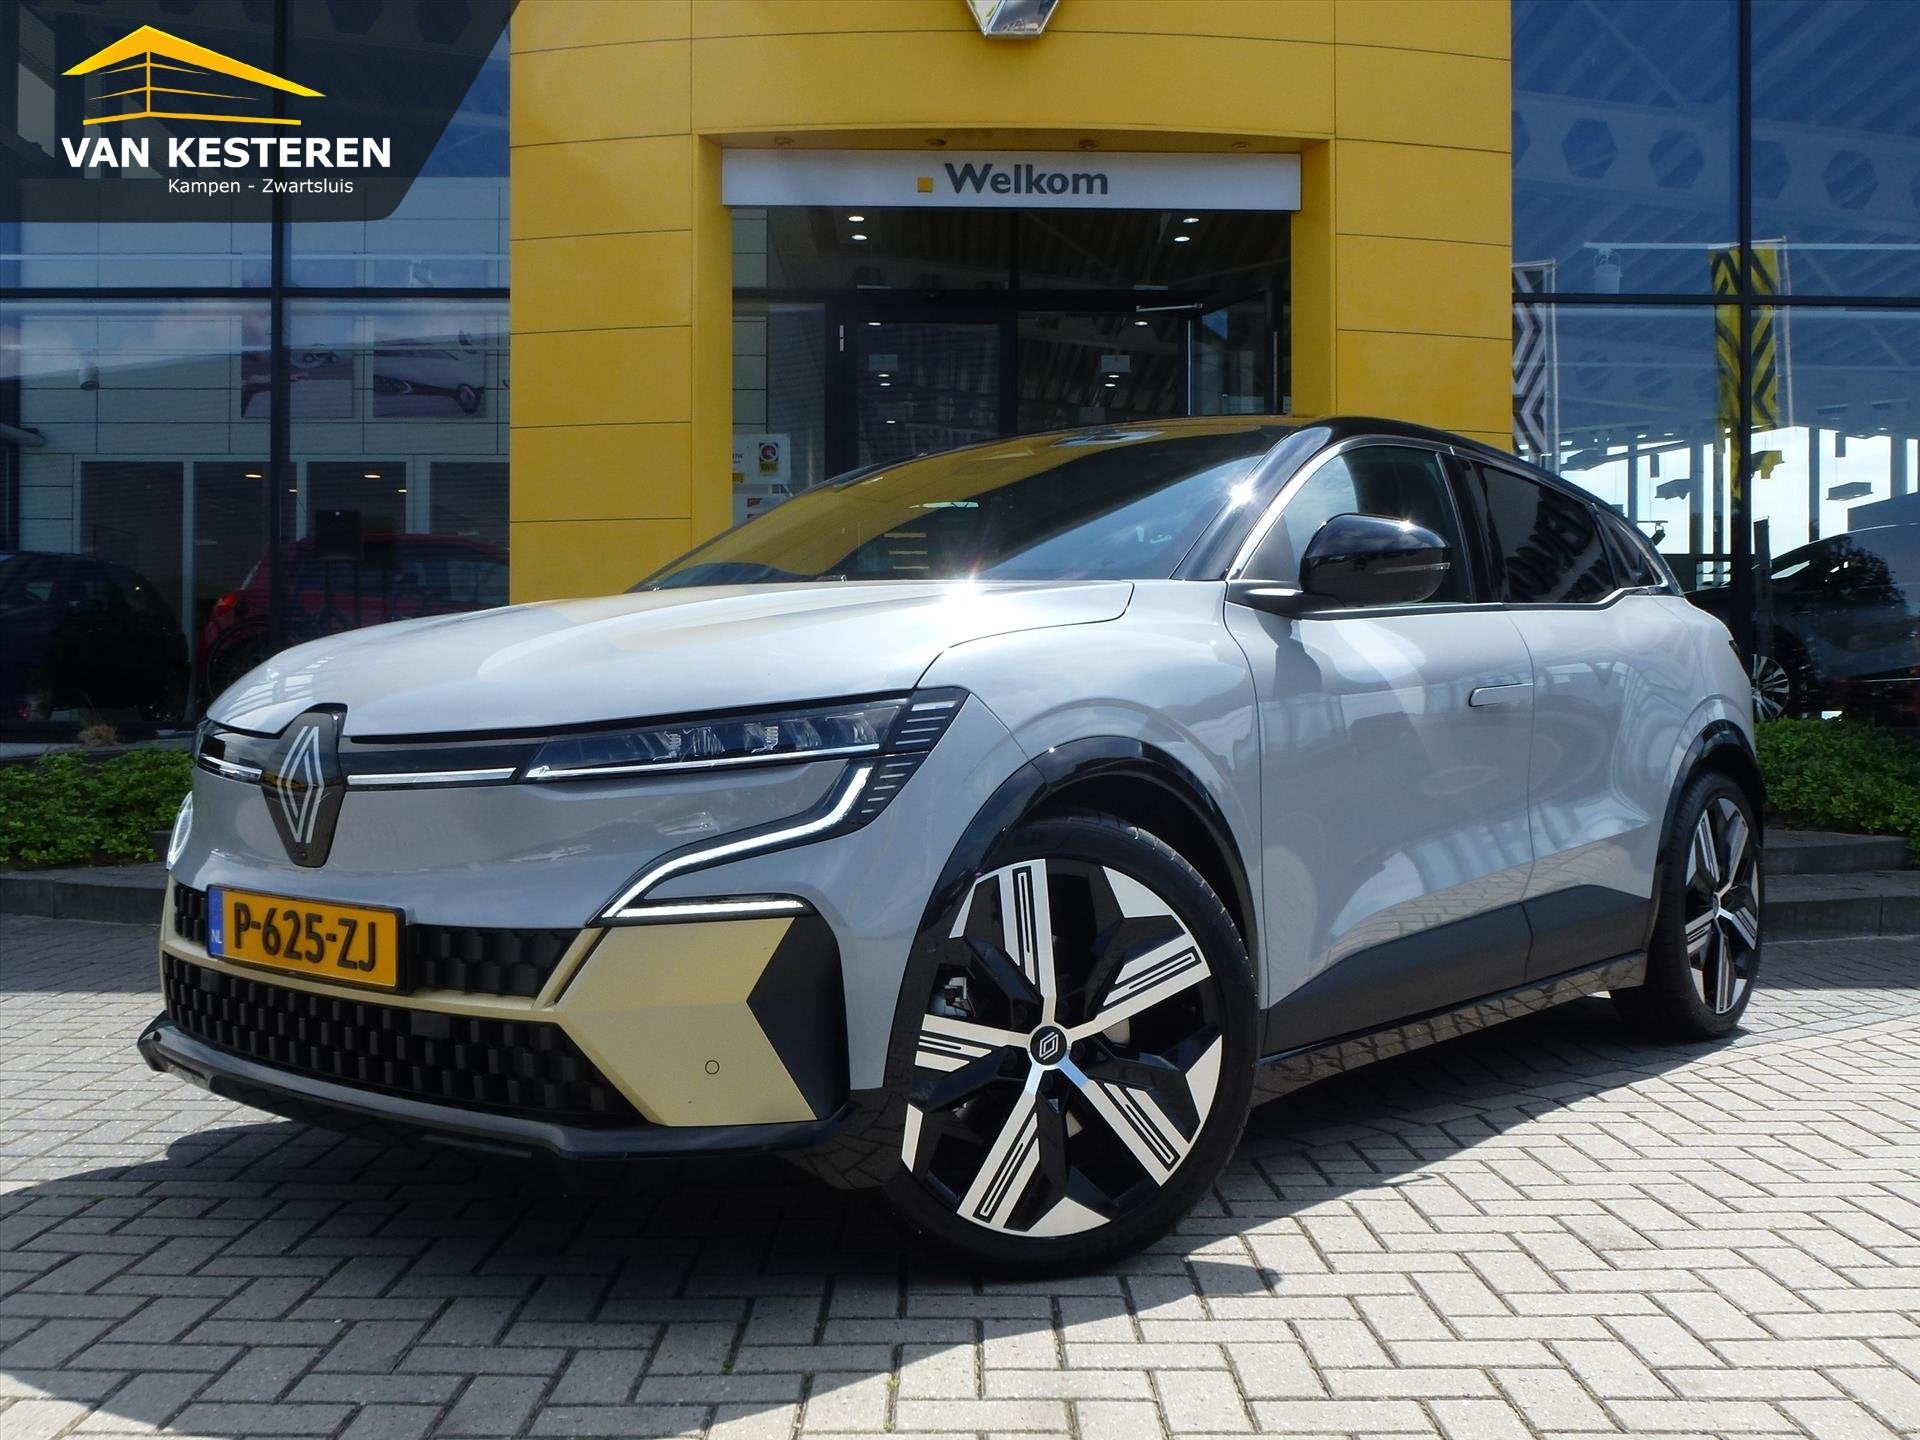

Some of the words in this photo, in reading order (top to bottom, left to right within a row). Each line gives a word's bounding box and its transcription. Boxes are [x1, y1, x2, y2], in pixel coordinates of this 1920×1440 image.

[944, 162, 1109, 195] Welkom
[211, 929, 223, 944] NL
[234, 902, 376, 972] P-625-ZJ
